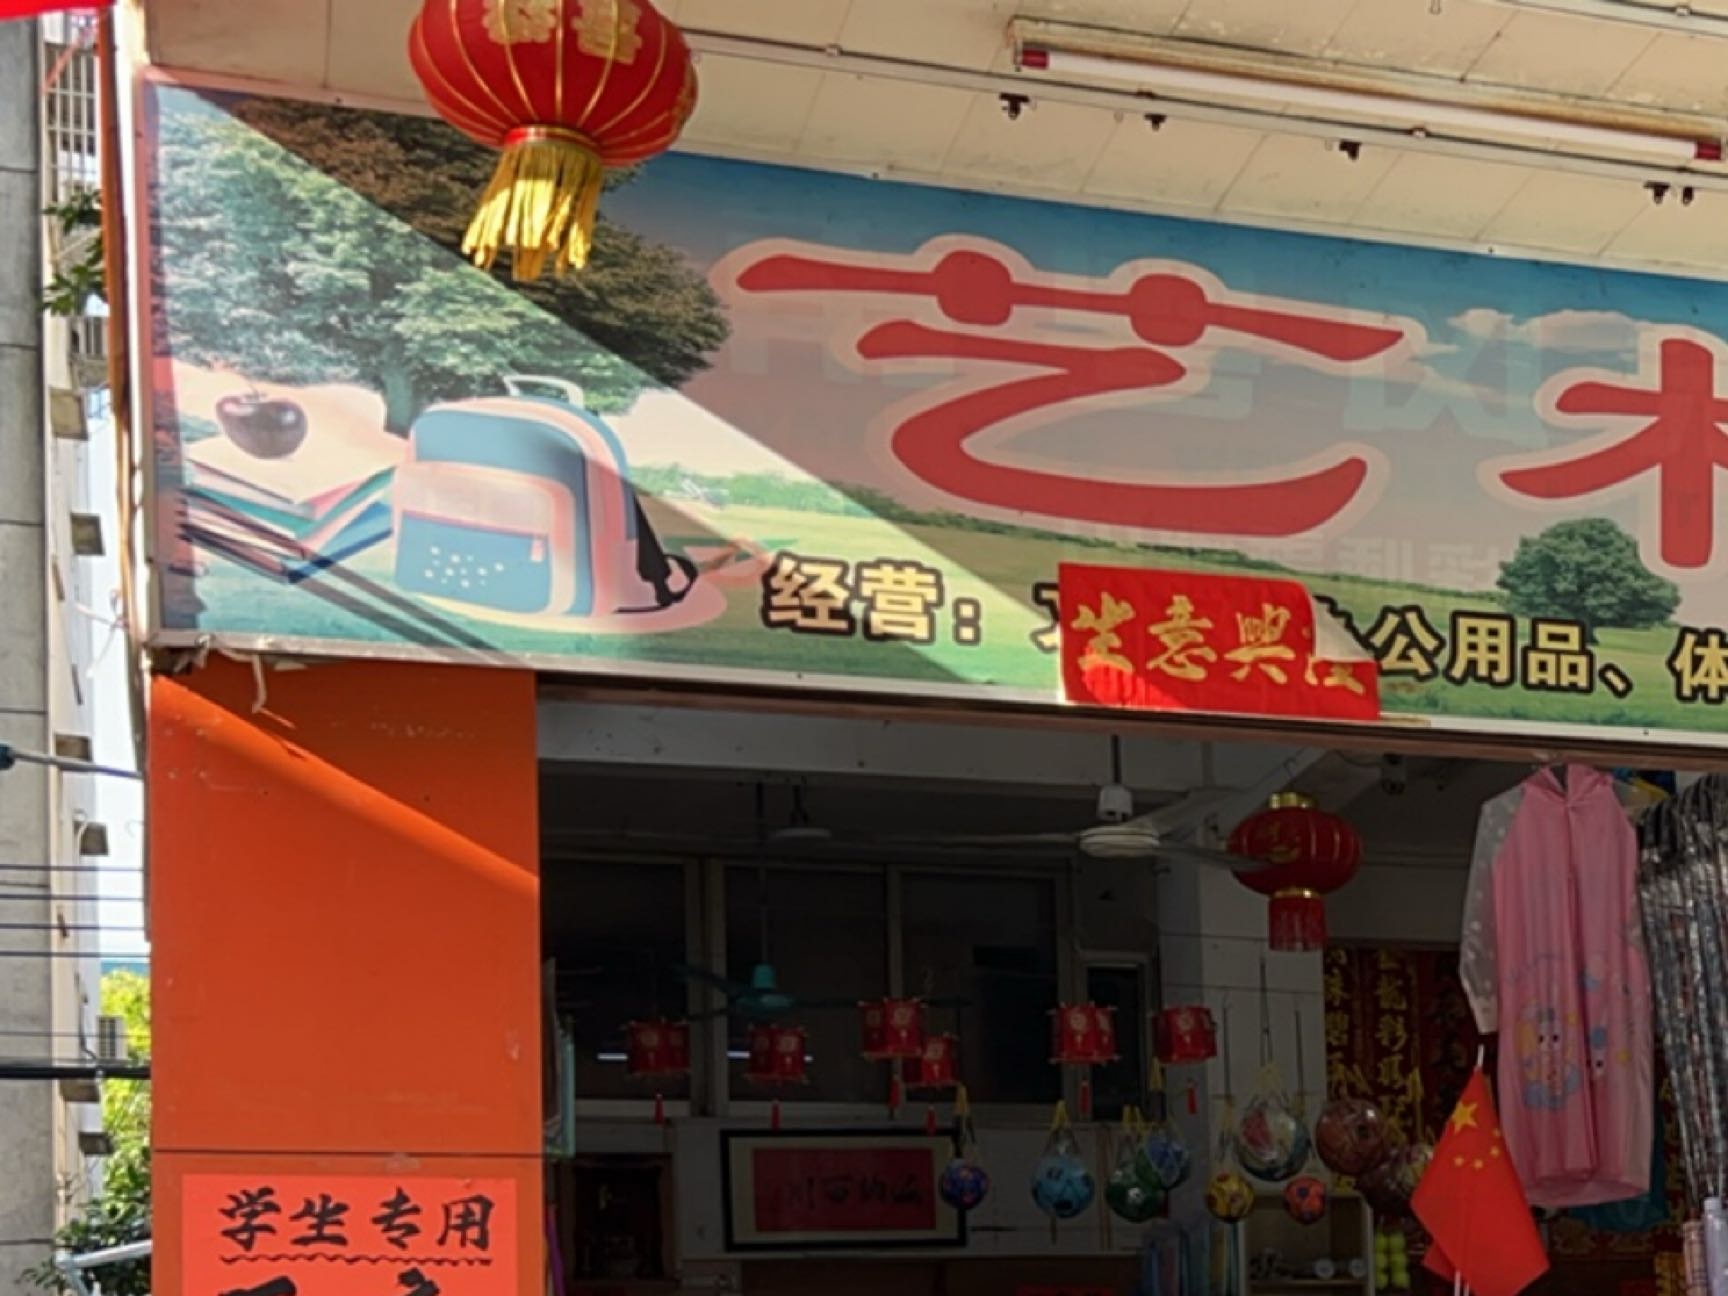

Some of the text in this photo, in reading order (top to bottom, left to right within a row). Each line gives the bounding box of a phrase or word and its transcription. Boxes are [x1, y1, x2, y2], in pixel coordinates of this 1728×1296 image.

[765, 553, 1060, 650] 经营：
[218, 1186, 494, 1251] 学生专用
